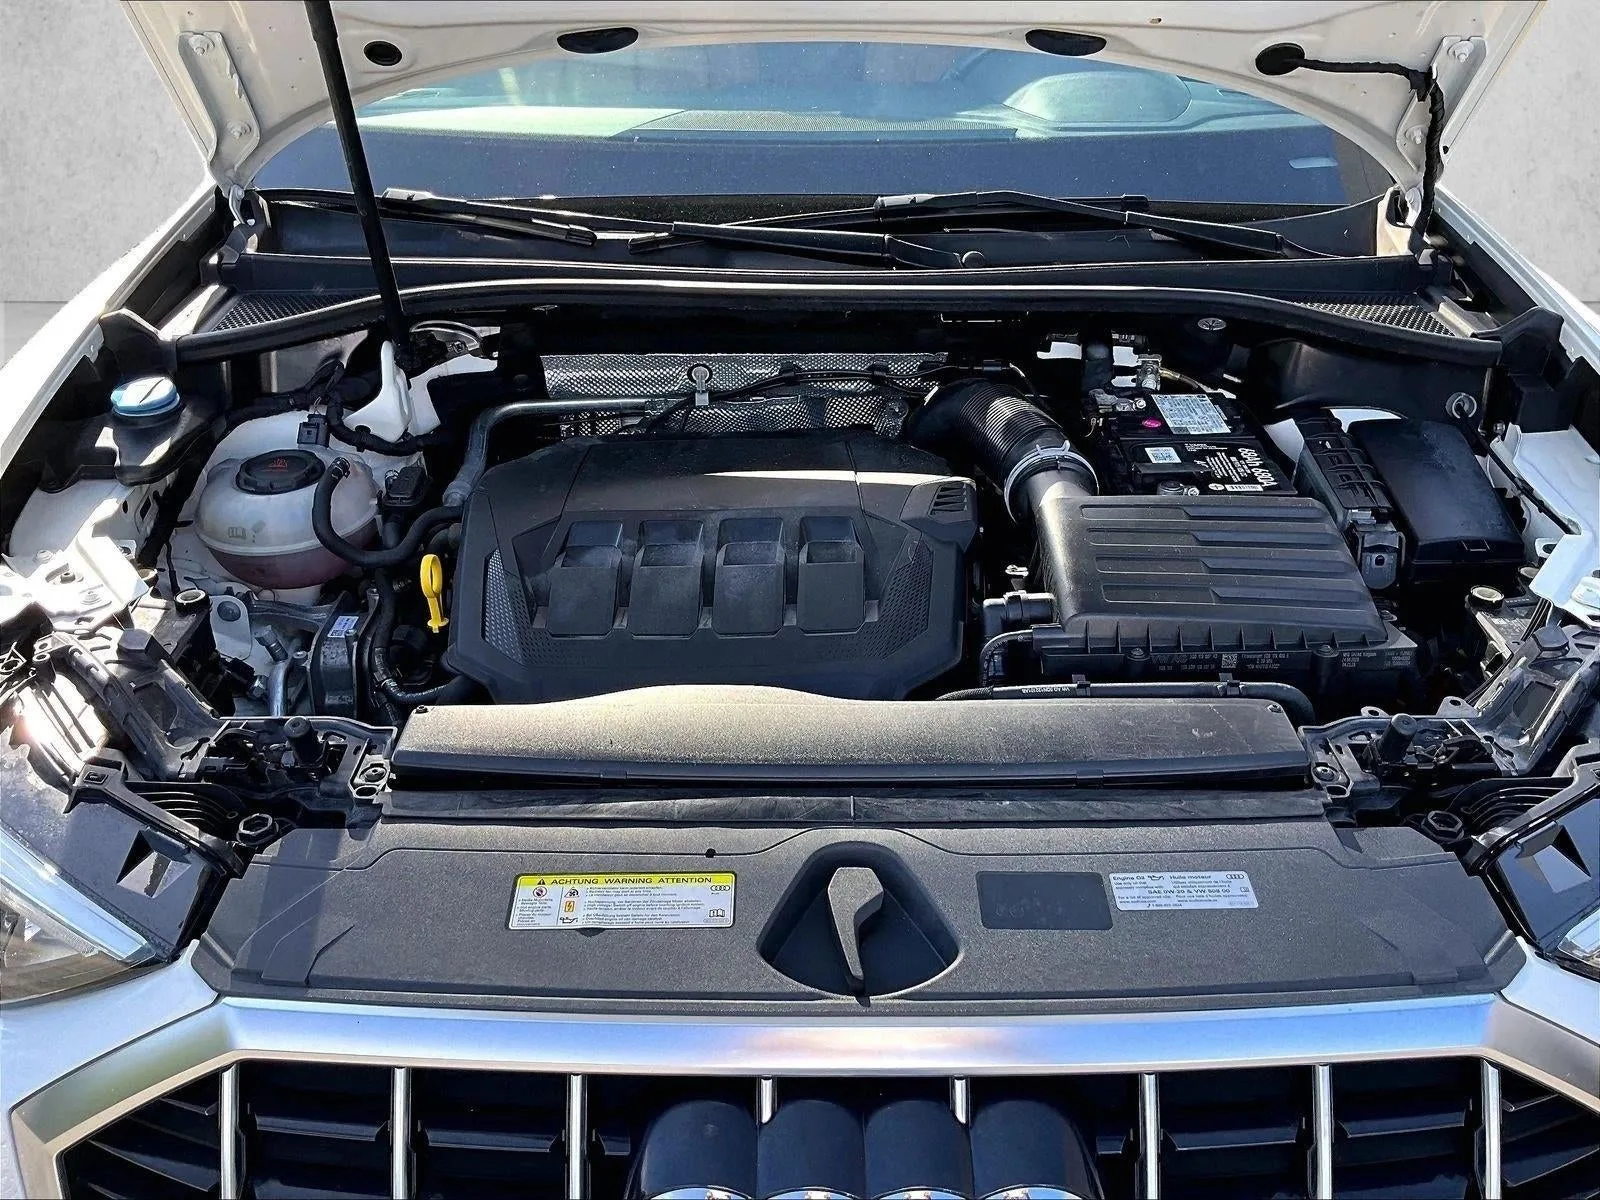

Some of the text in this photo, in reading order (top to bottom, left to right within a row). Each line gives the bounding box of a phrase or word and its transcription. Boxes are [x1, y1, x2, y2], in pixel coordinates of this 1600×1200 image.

[1238, 448, 1263, 467] 68Ah
[1251, 468, 1278, 487] 680A
[551, 876, 712, 885] ACHTUNG WARNING ATTENTION
